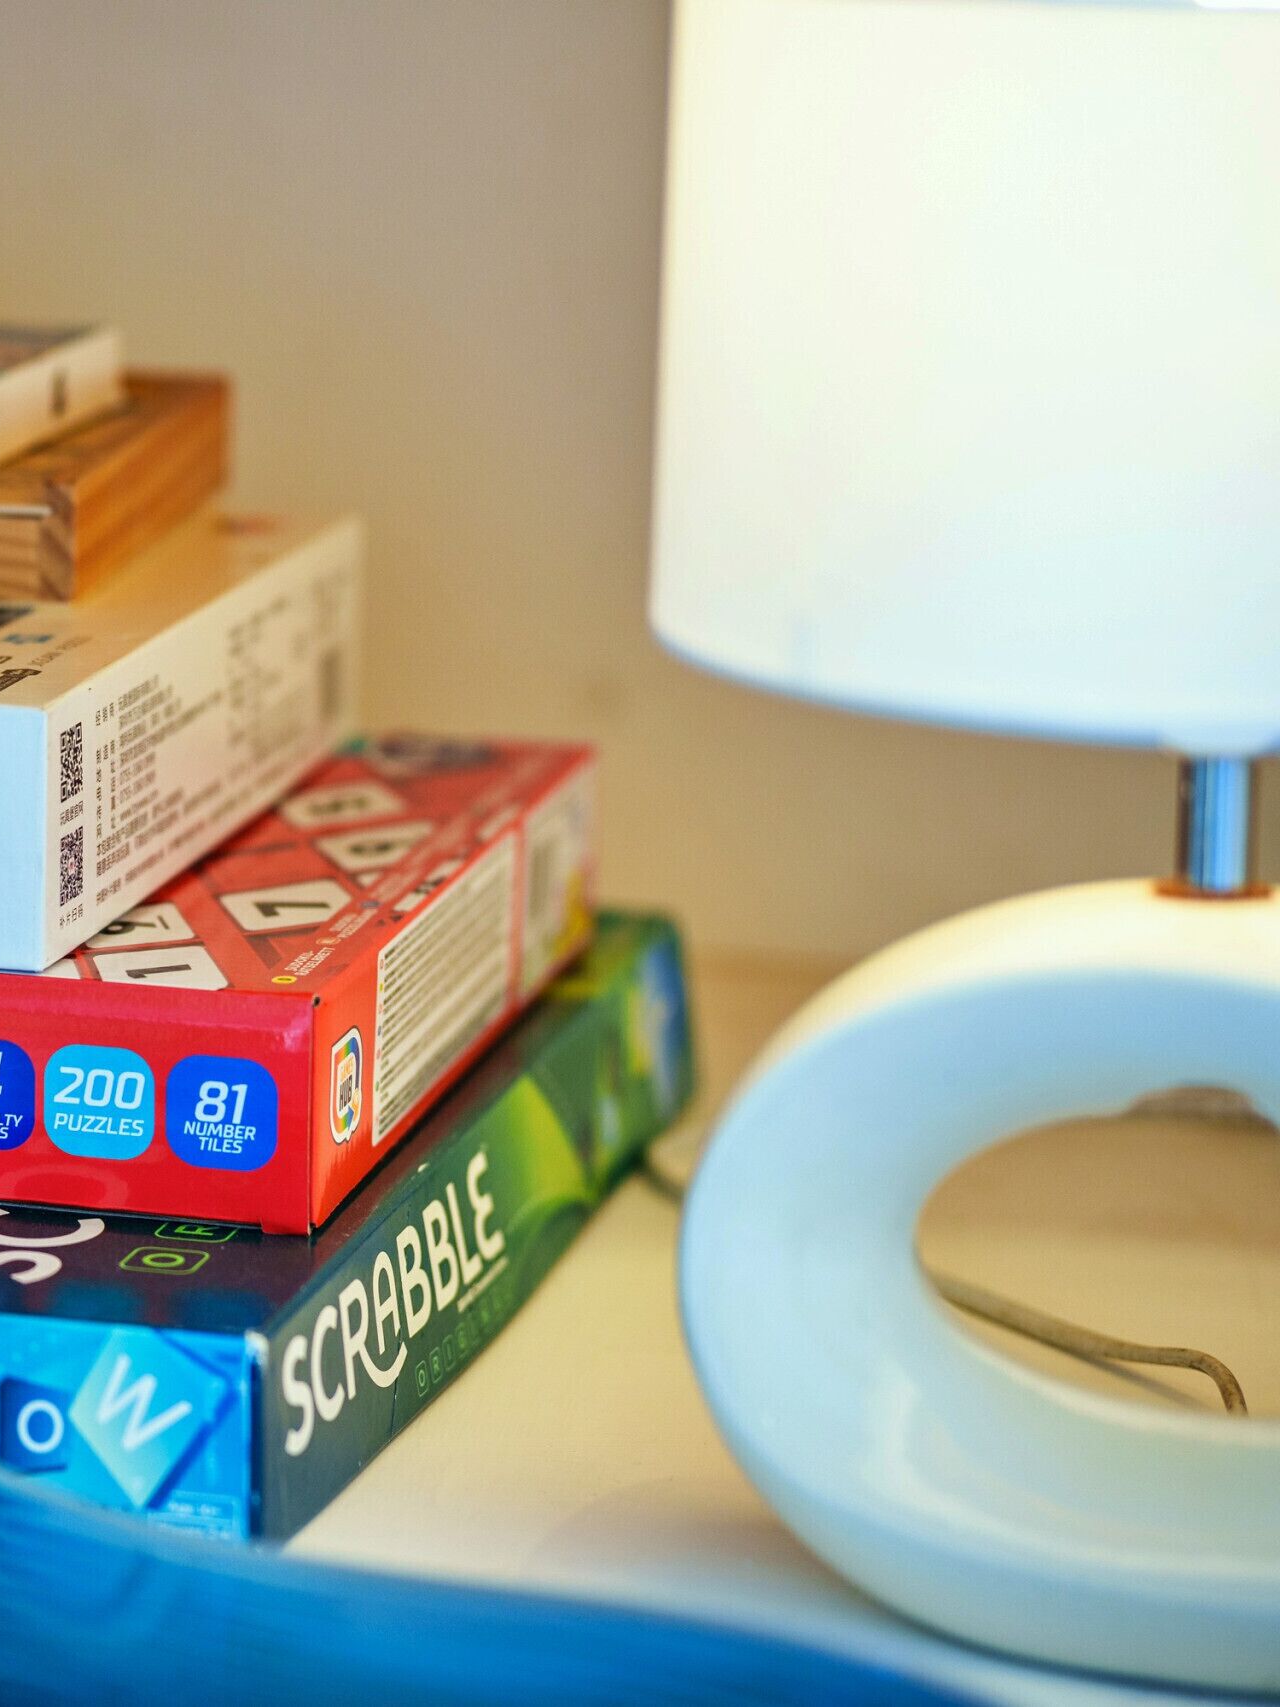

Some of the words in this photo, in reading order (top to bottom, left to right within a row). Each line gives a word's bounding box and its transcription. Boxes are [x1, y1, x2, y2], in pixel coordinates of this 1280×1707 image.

[53, 1066, 145, 1110] 200
[194, 1080, 249, 1125] 81
[53, 1112, 145, 1137] PUZZLES
[183, 1120, 257, 1141] NUMBER
[198, 1136, 243, 1154] TILES
[282, 1151, 505, 1457] SCRABBLE
